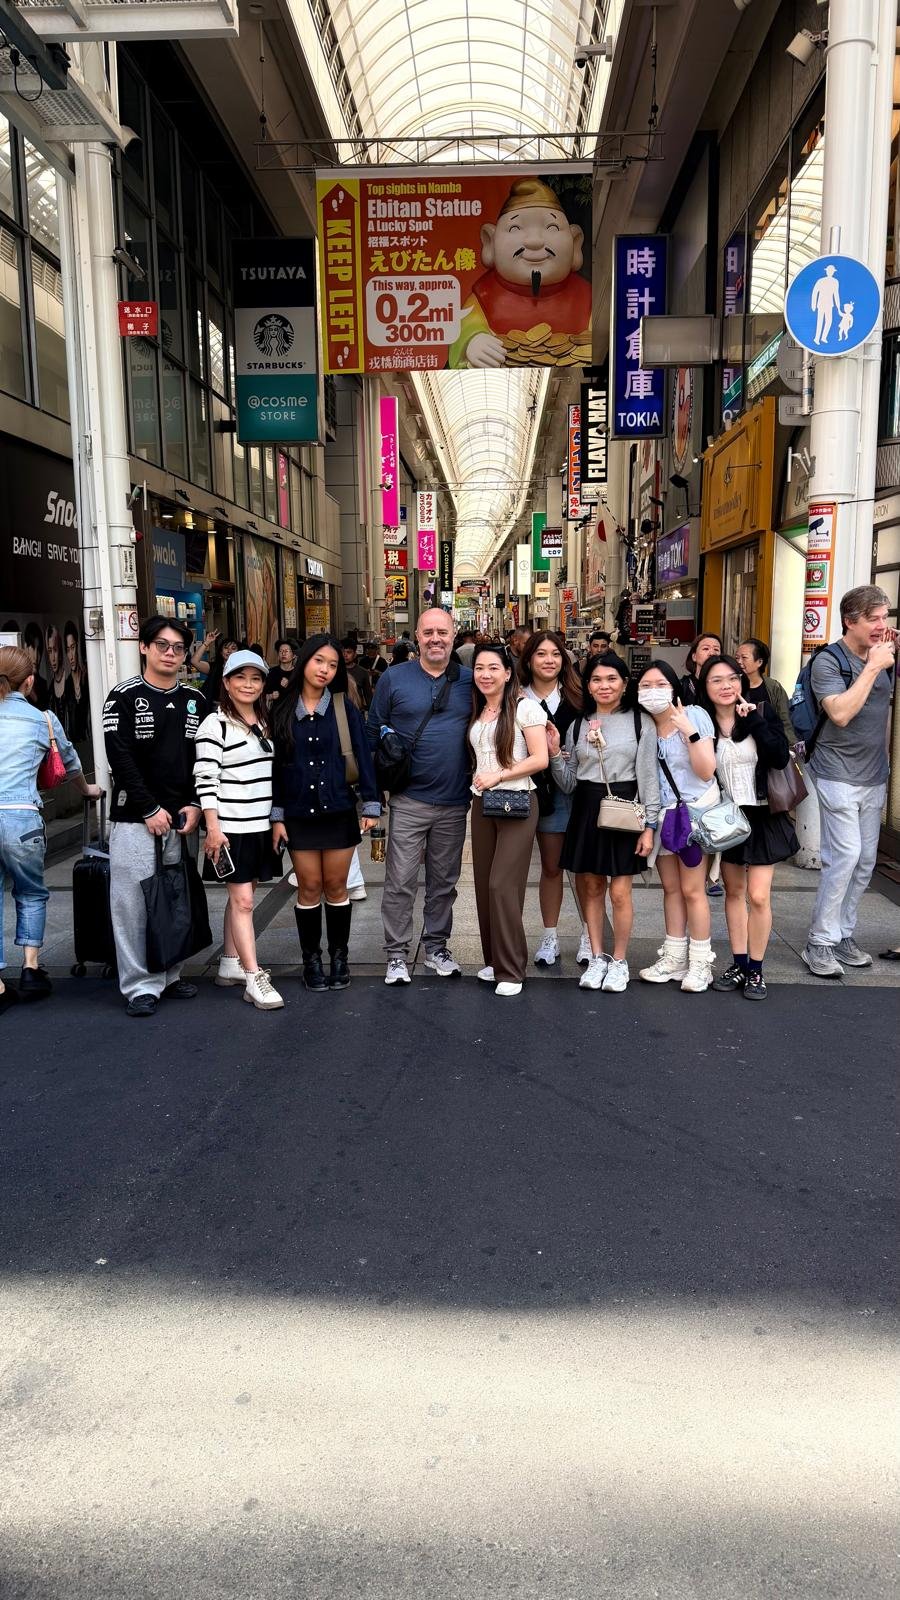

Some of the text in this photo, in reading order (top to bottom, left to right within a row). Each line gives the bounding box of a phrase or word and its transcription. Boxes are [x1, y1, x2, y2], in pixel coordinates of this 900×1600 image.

[367, 182, 462, 195] Top sights in Namba
[368, 197, 482, 219] Ebitan Statue
[368, 220, 433, 234] A Lucky Spot
[368, 236, 428, 248] 招福スポット
[369, 248, 476, 272] えびたん像
[240, 266, 307, 281] TSUTAYA
[326, 219, 354, 345] KEEP LEFT
[372, 280, 456, 292] This way, approx.
[376, 292, 454, 324] 0.2mi
[386, 324, 444, 342] 300m
[393, 348, 414, 356] なんば
[246, 362, 304, 370] STARBUCKS
[368, 354, 438, 370] 戎橋筋商店街
[248, 396, 308, 408] @cosme
[588, 388, 606, 422] HAT
[260, 411, 296, 420] STORE
[618, 412, 660, 428] TOKIA
[588, 426, 606, 478] FLAVA
[48, 543, 68, 562] SAVE
